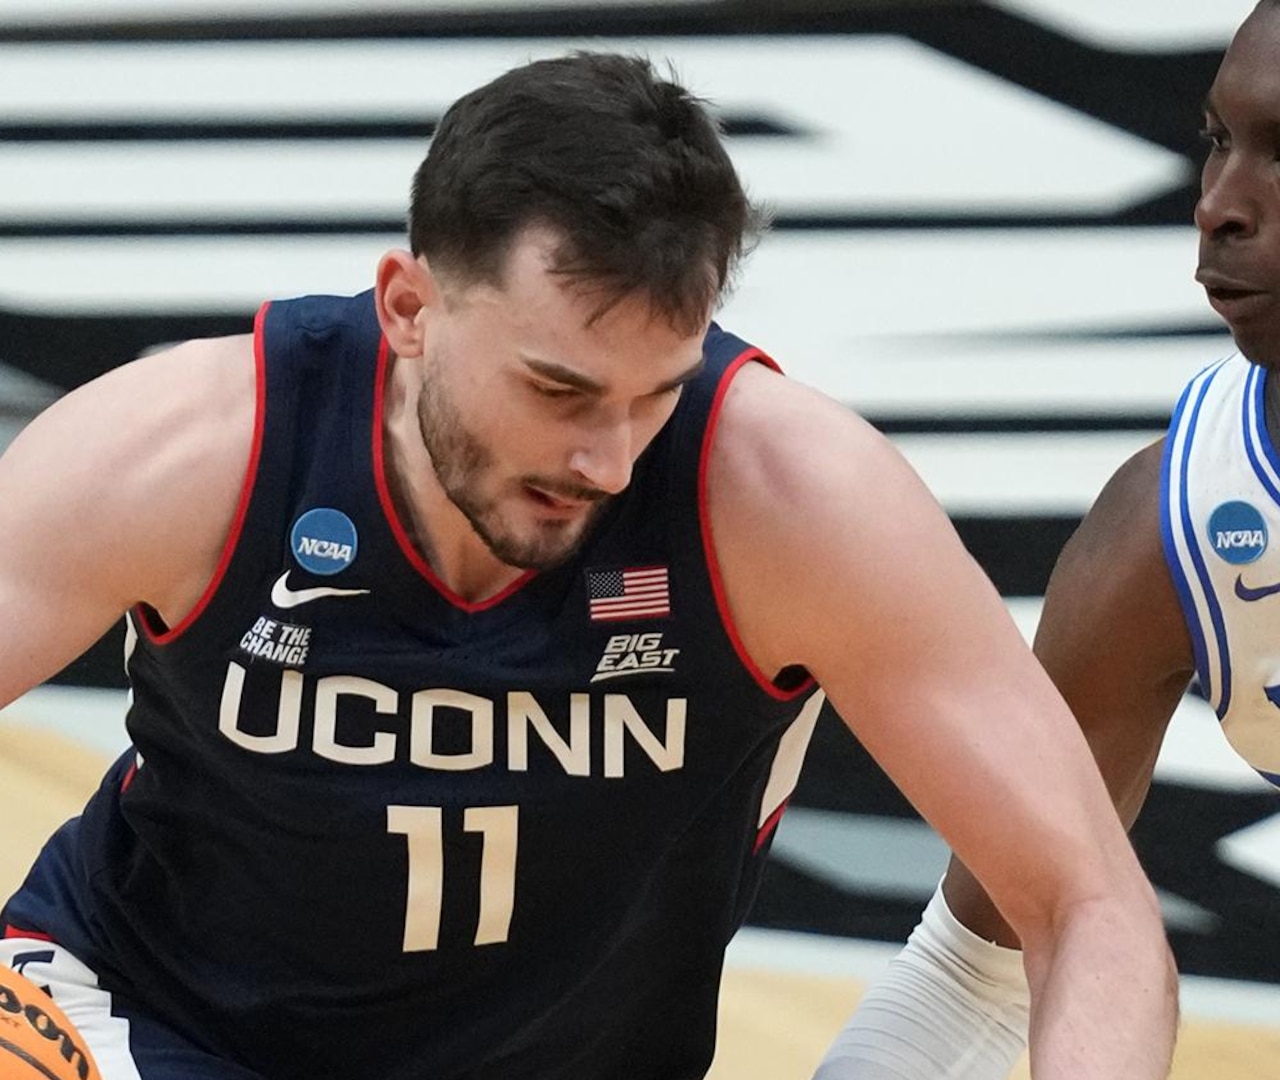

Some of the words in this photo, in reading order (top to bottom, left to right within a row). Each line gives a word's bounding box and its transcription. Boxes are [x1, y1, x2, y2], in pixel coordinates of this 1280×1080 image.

[298, 537, 352, 562] NCAA
[1216, 530, 1264, 549] NCAA
[252, 616, 277, 638] BE
[280, 626, 312, 646] THE
[604, 633, 663, 654] BIG
[240, 631, 310, 665] CHANGE
[596, 649, 680, 672] EAST
[219, 661, 687, 778] UCONN
[386, 804, 519, 952] 11
